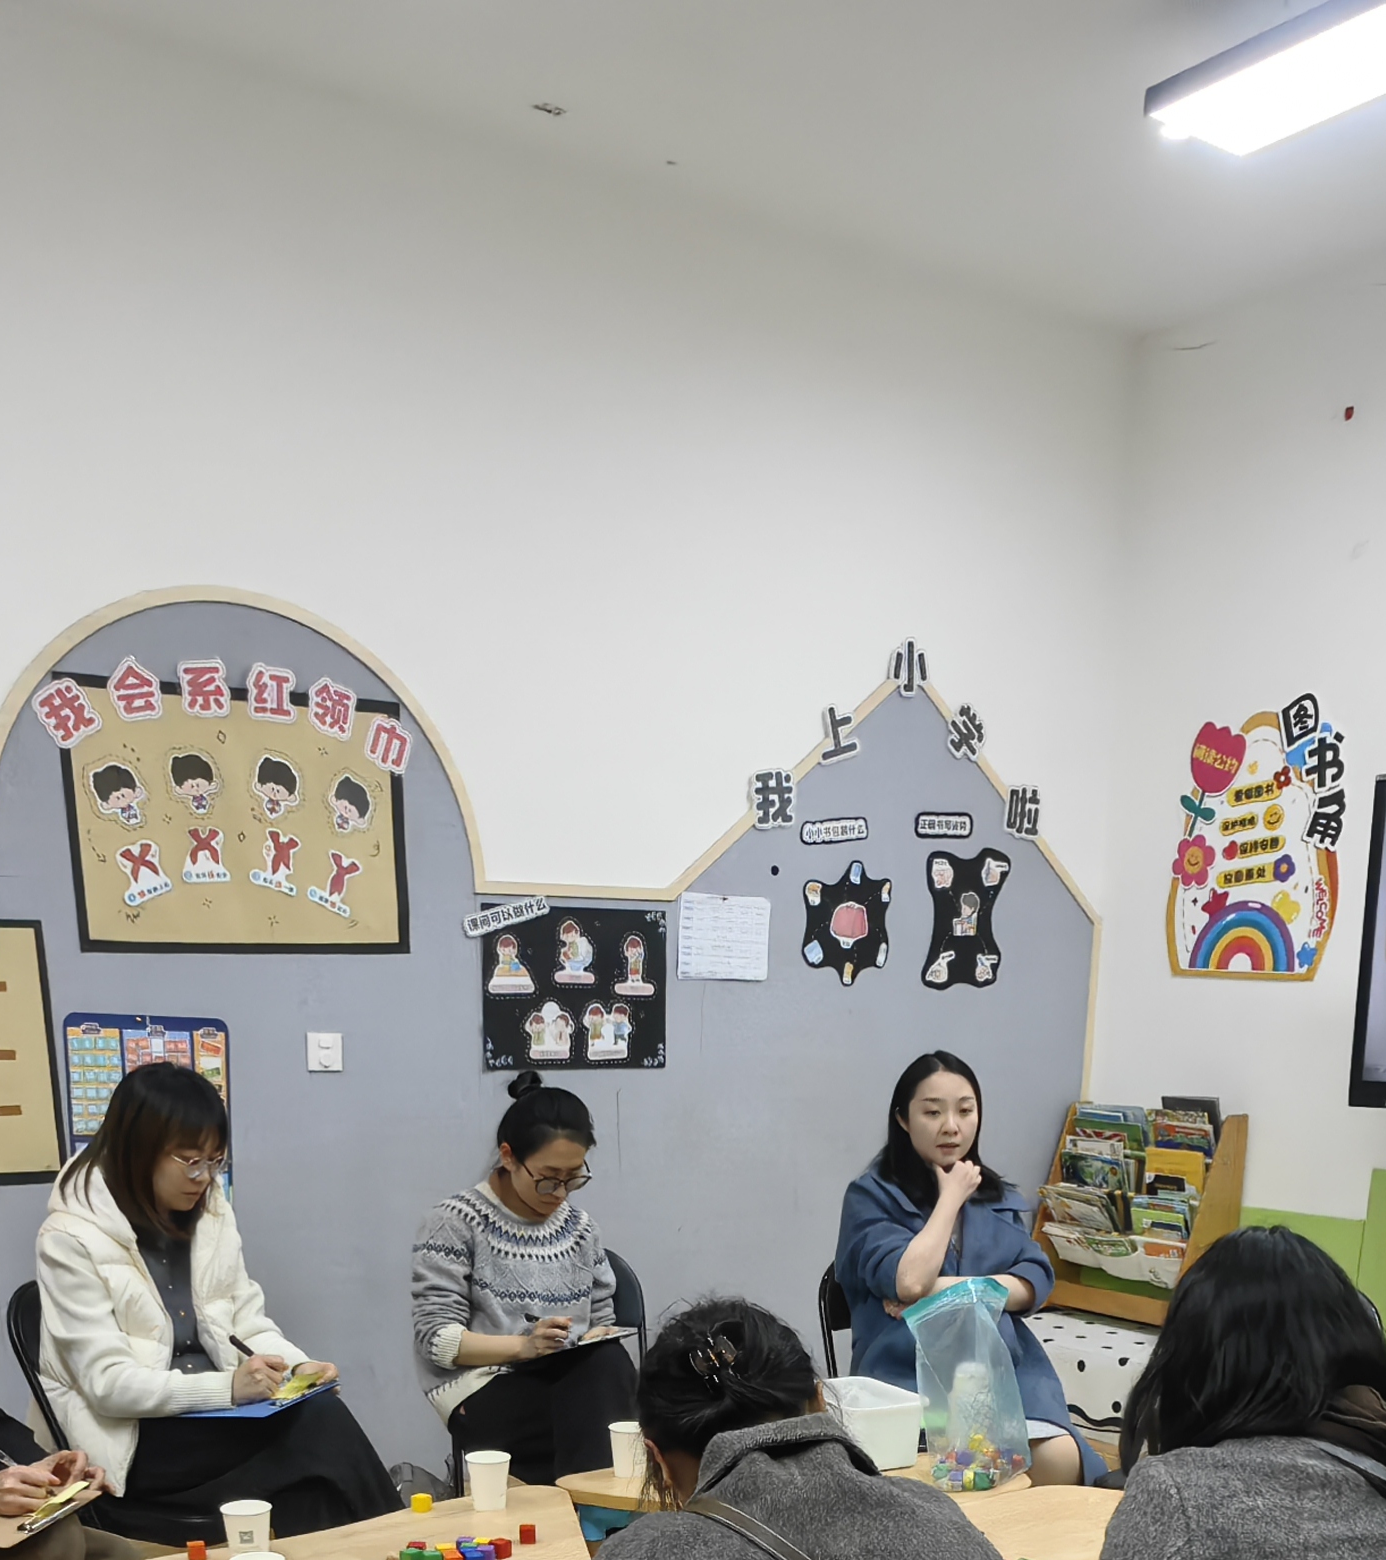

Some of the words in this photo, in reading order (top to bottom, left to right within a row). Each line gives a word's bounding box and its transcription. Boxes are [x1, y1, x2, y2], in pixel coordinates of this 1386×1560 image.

[38, 664, 408, 768] 我会系红领巾
[1281, 693, 1345, 848] 图书角
[467, 898, 547, 932] 课间可以做什么
[1308, 878, 1328, 938] WELCOME
